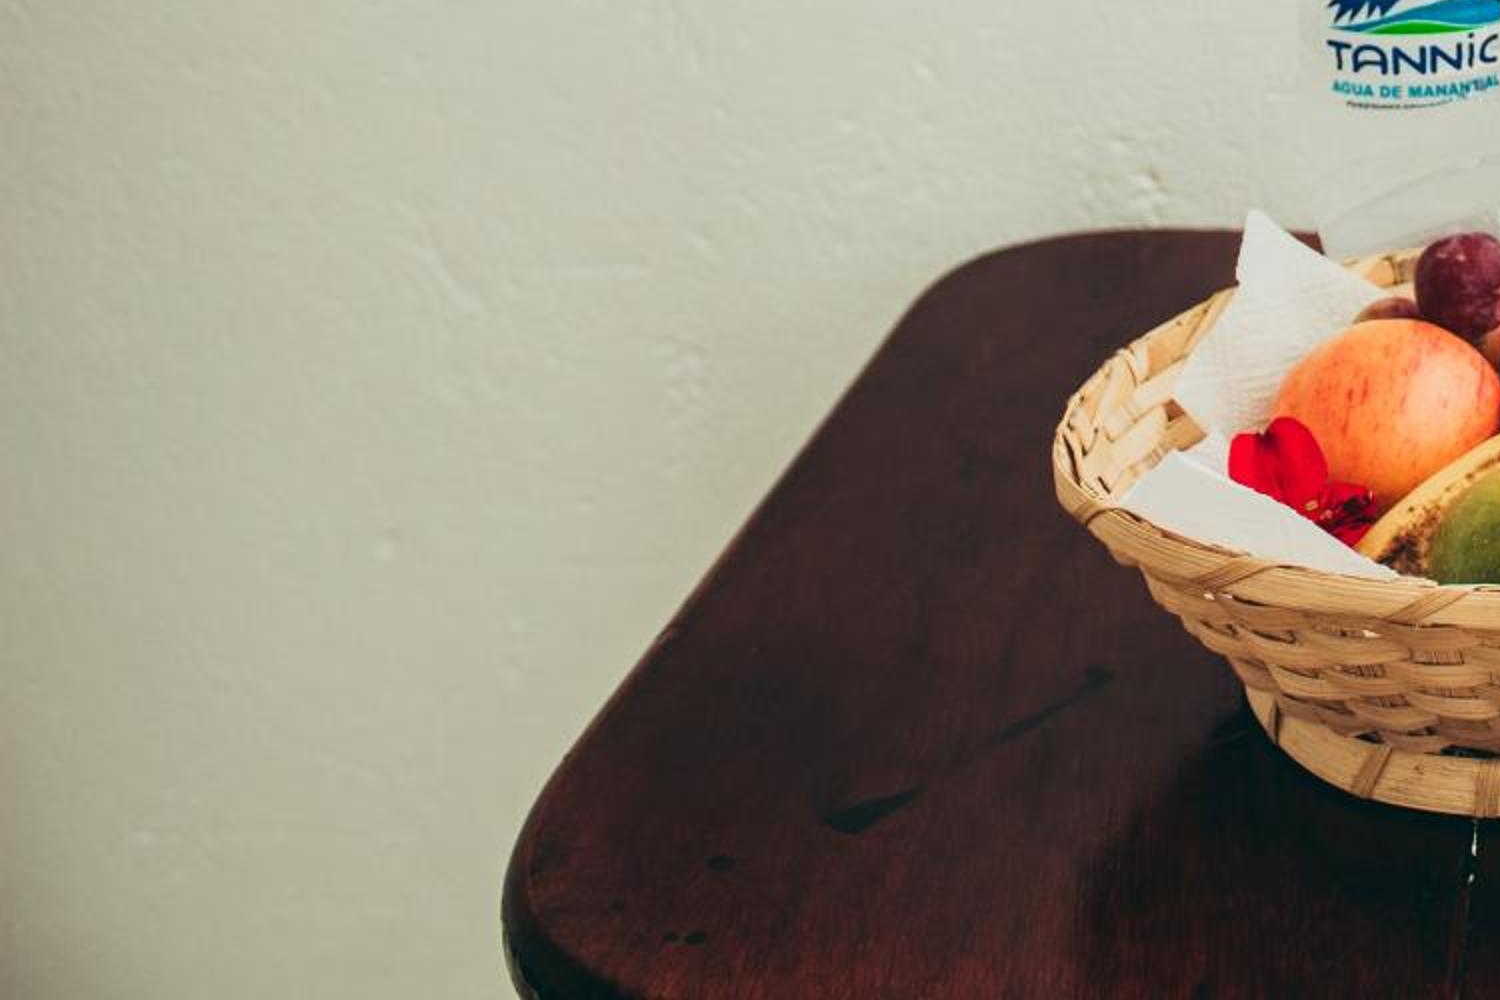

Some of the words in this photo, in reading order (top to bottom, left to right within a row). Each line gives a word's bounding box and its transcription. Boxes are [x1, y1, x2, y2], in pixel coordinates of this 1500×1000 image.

[1332, 79, 1373, 97] AGUA
[1379, 84, 1402, 99] DE
[1408, 73, 1500, 98] MANANTIAL
